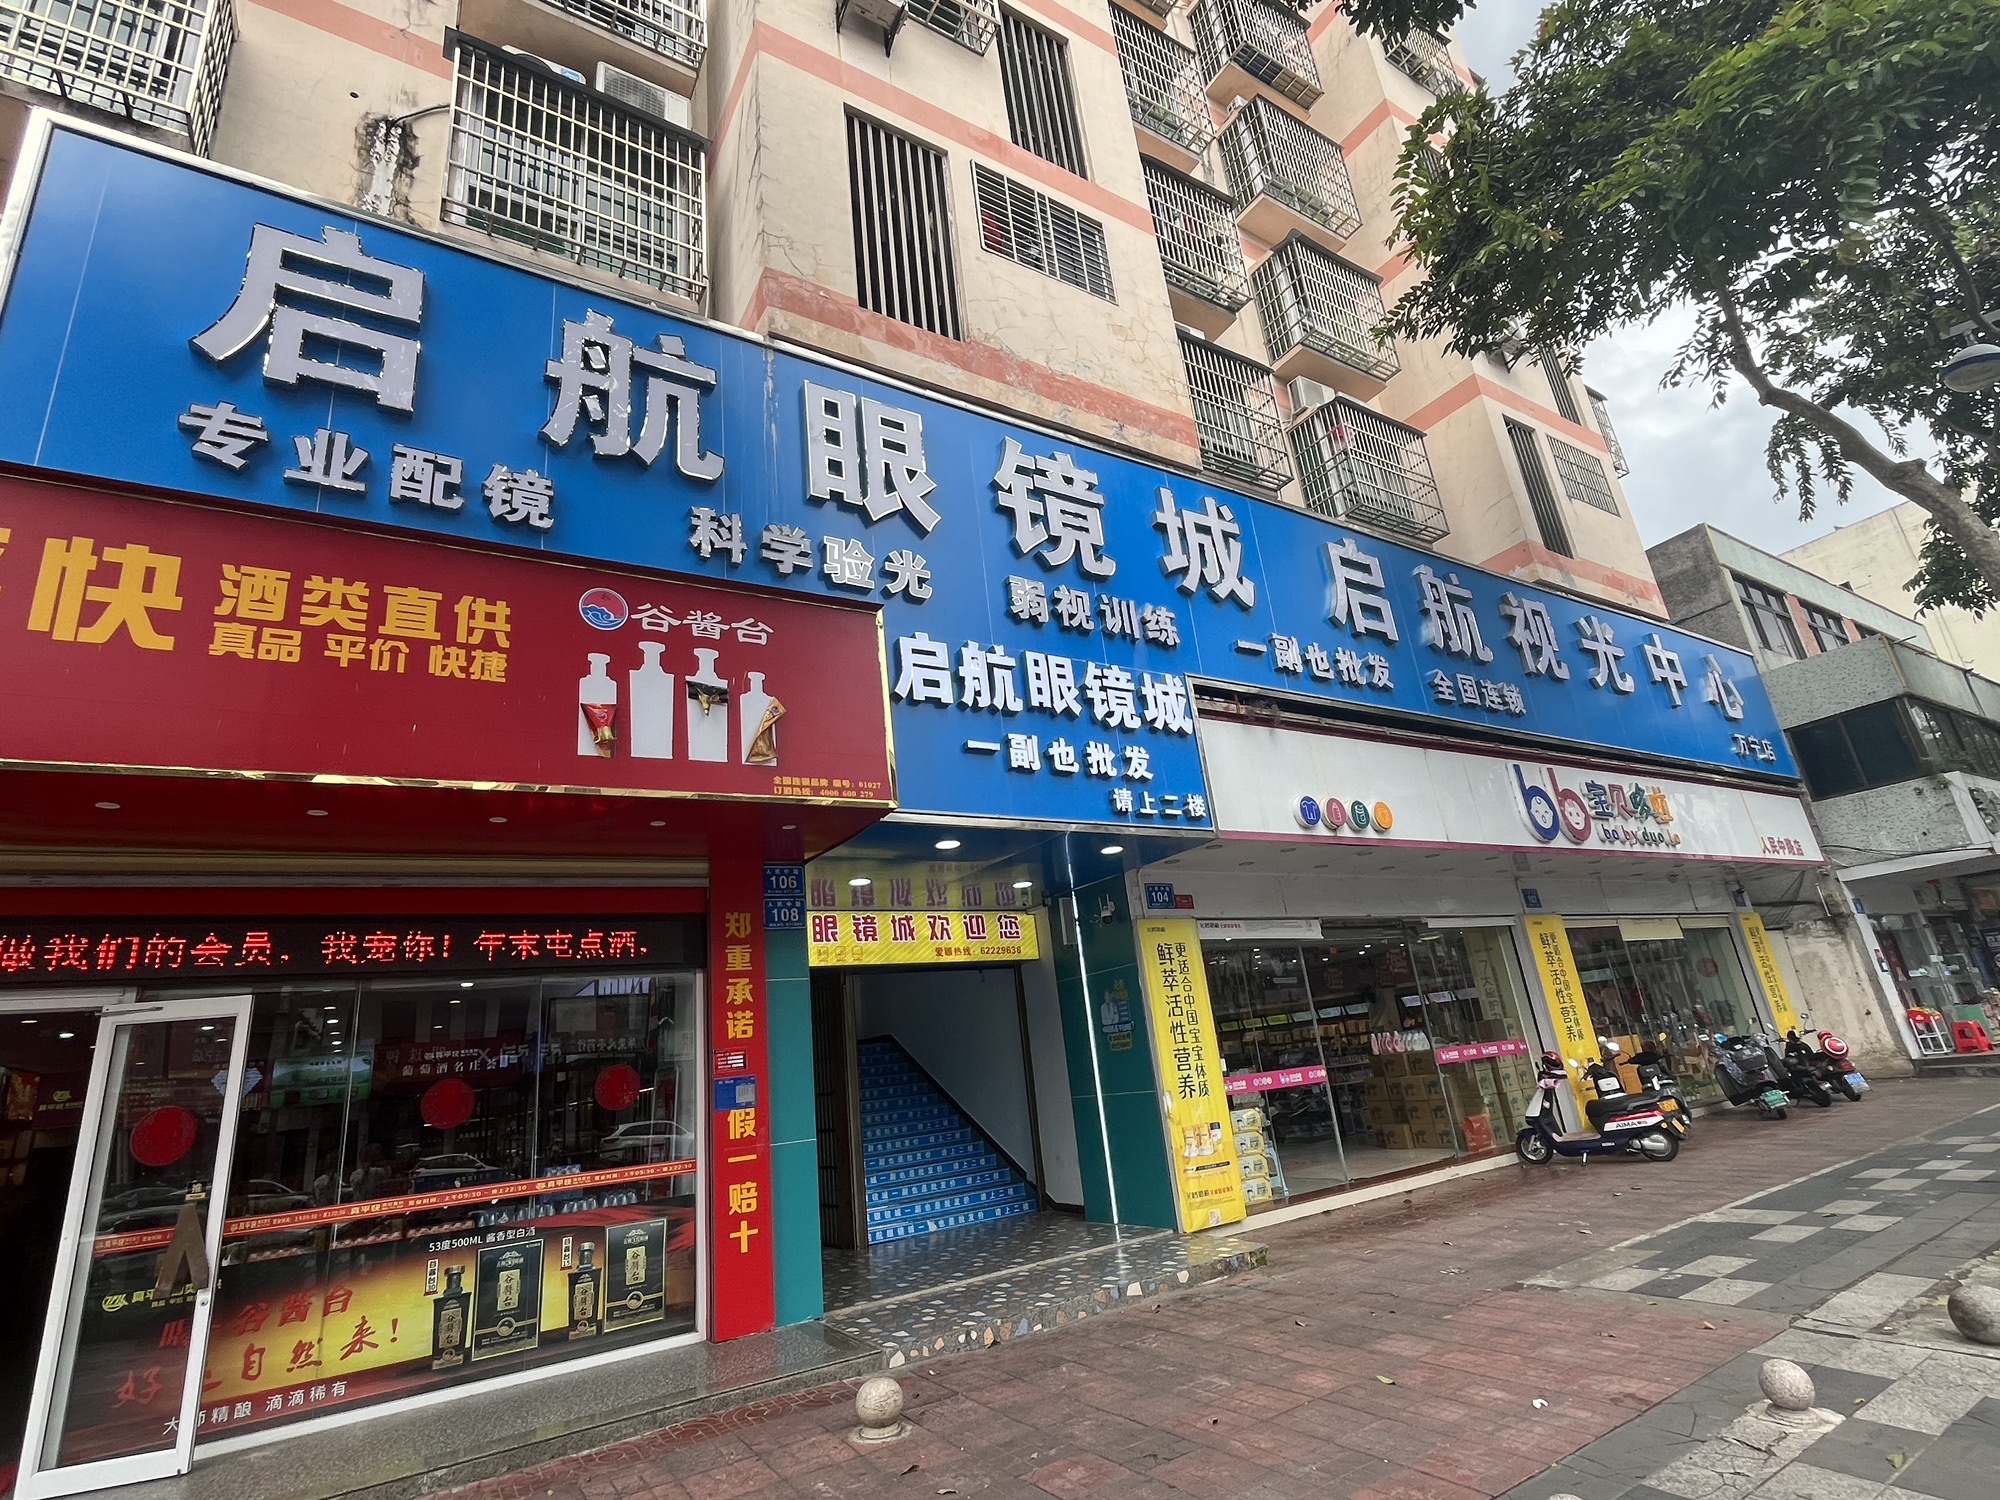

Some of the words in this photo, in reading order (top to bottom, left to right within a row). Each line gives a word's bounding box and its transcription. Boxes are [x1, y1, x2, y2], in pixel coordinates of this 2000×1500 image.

[189, 223, 1256, 608] 启航眼镜城
[1325, 537, 1745, 721] 启航视光中心
[178, 401, 554, 531] 专业配镜
[689, 506, 933, 602] 科学验光
[1006, 575, 1182, 648] 弱视训练
[1234, 632, 1394, 690] 一副也批发
[1431, 668, 1526, 717] 全国连锁
[0, 527, 182, 651] 快
[213, 563, 511, 648] 酒类直供
[630, 602, 774, 646] 谷酱台
[209, 621, 303, 663] 真品
[324, 633, 409, 673] 平价
[427, 644, 508, 683] 快捷
[895, 632, 1194, 736] 启航眼镜城
[966, 733, 1154, 781] 一副也批发
[1112, 788, 1208, 819] 请上二楼
[1761, 836, 1804, 856] 人民中路店
[770, 875, 797, 889] 106
[1151, 891, 1169, 903] 104
[772, 908, 799, 922] 108
[812, 914, 1022, 942] 眼镜城欢迎您
[725, 911, 754, 1040] 郑重承诺
[1156, 942, 1197, 1100] 鲜萃活性营养
[1174, 943, 1210, 1098] 更适合中国宝宝体质
[1616, 1120, 1637, 1129] AIMA
[727, 1108, 758, 1253] 假一赔十
[429, 1236, 483, 1252] 53度500ML
[486, 1227, 536, 1243] 酱香型白酒
[113, 1316, 400, 1409] 好自然来！
[266, 1380, 348, 1412] 滴滴稀有
